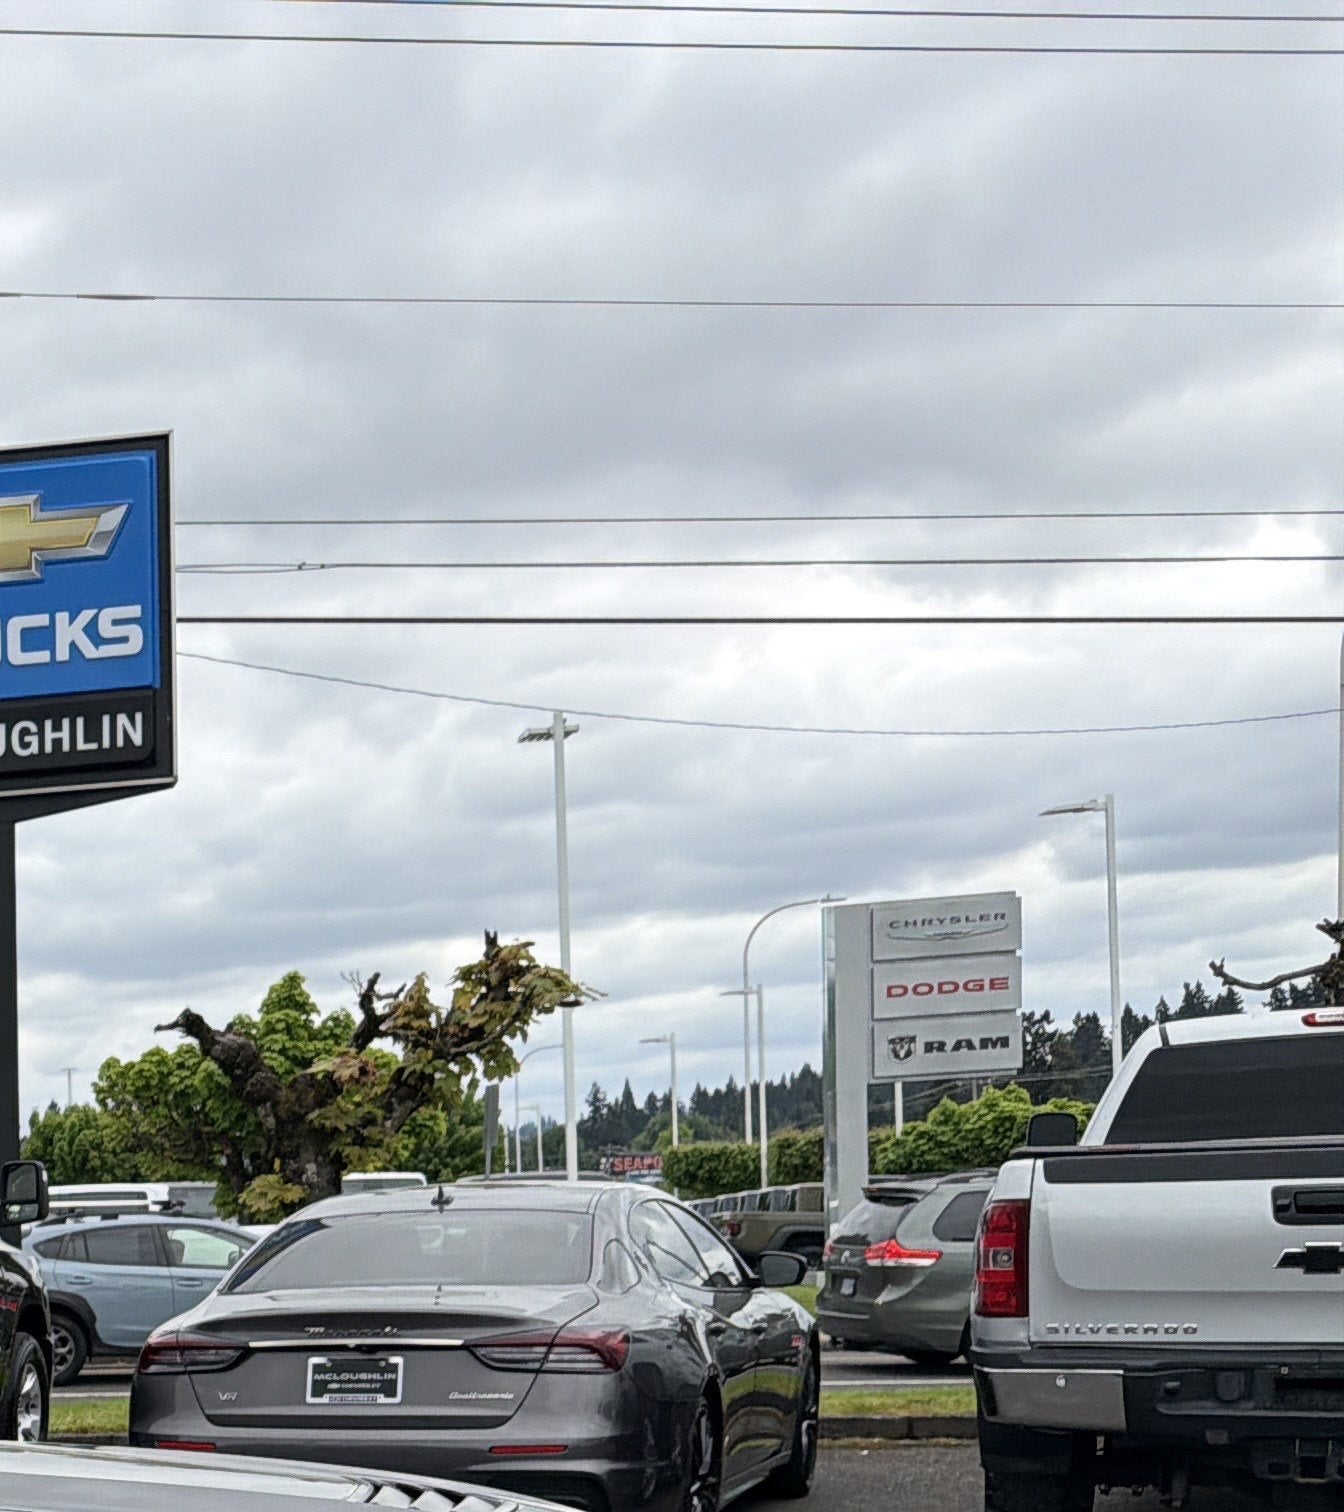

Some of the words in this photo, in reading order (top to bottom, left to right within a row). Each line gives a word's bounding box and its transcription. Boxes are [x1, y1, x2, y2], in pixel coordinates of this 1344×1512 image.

[888, 912, 1007, 930] CHRYSLER
[886, 976, 1010, 998] DODGE
[923, 1035, 1010, 1054] RAM
[1046, 1323, 1198, 1335] SILVERADO
